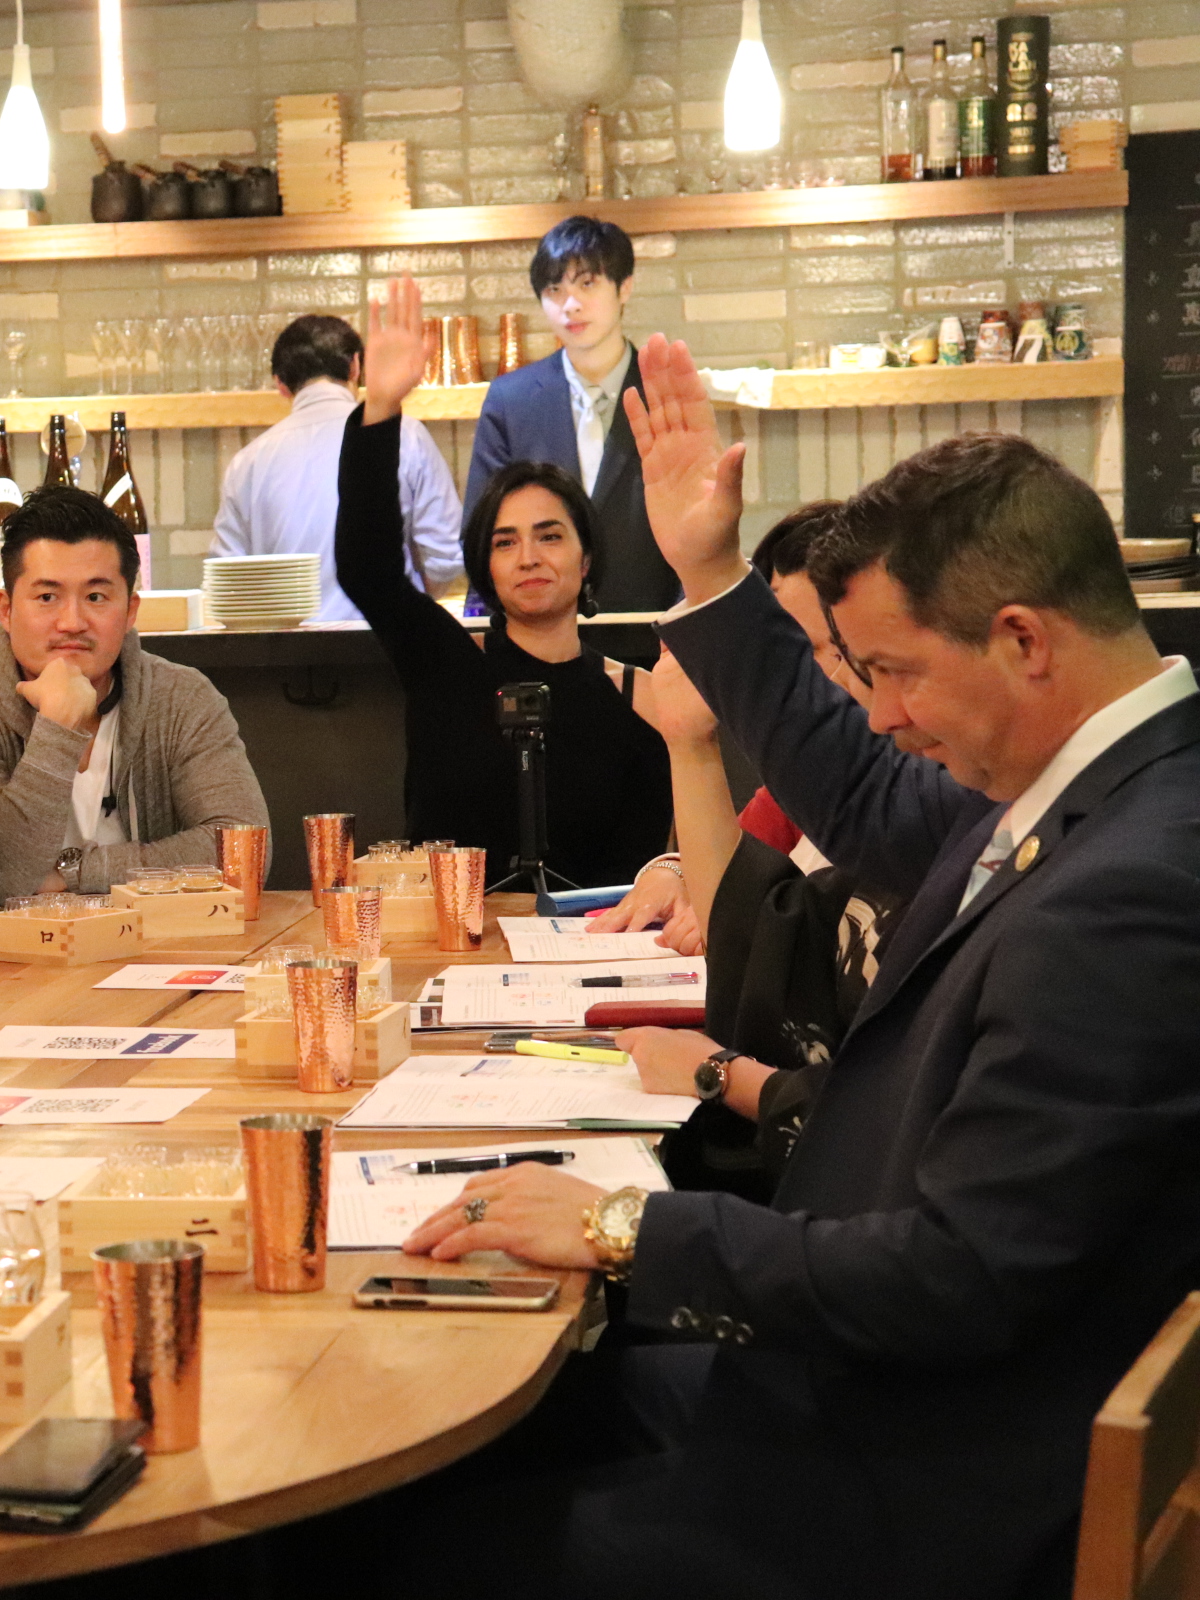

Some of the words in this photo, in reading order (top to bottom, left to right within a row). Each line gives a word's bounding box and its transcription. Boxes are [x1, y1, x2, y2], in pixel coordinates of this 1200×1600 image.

[207, 903, 229, 918] ハ
[41, 930, 54, 944] ロ
[118, 923, 132, 938] ハ
[185, 1217, 219, 1237] ニ
